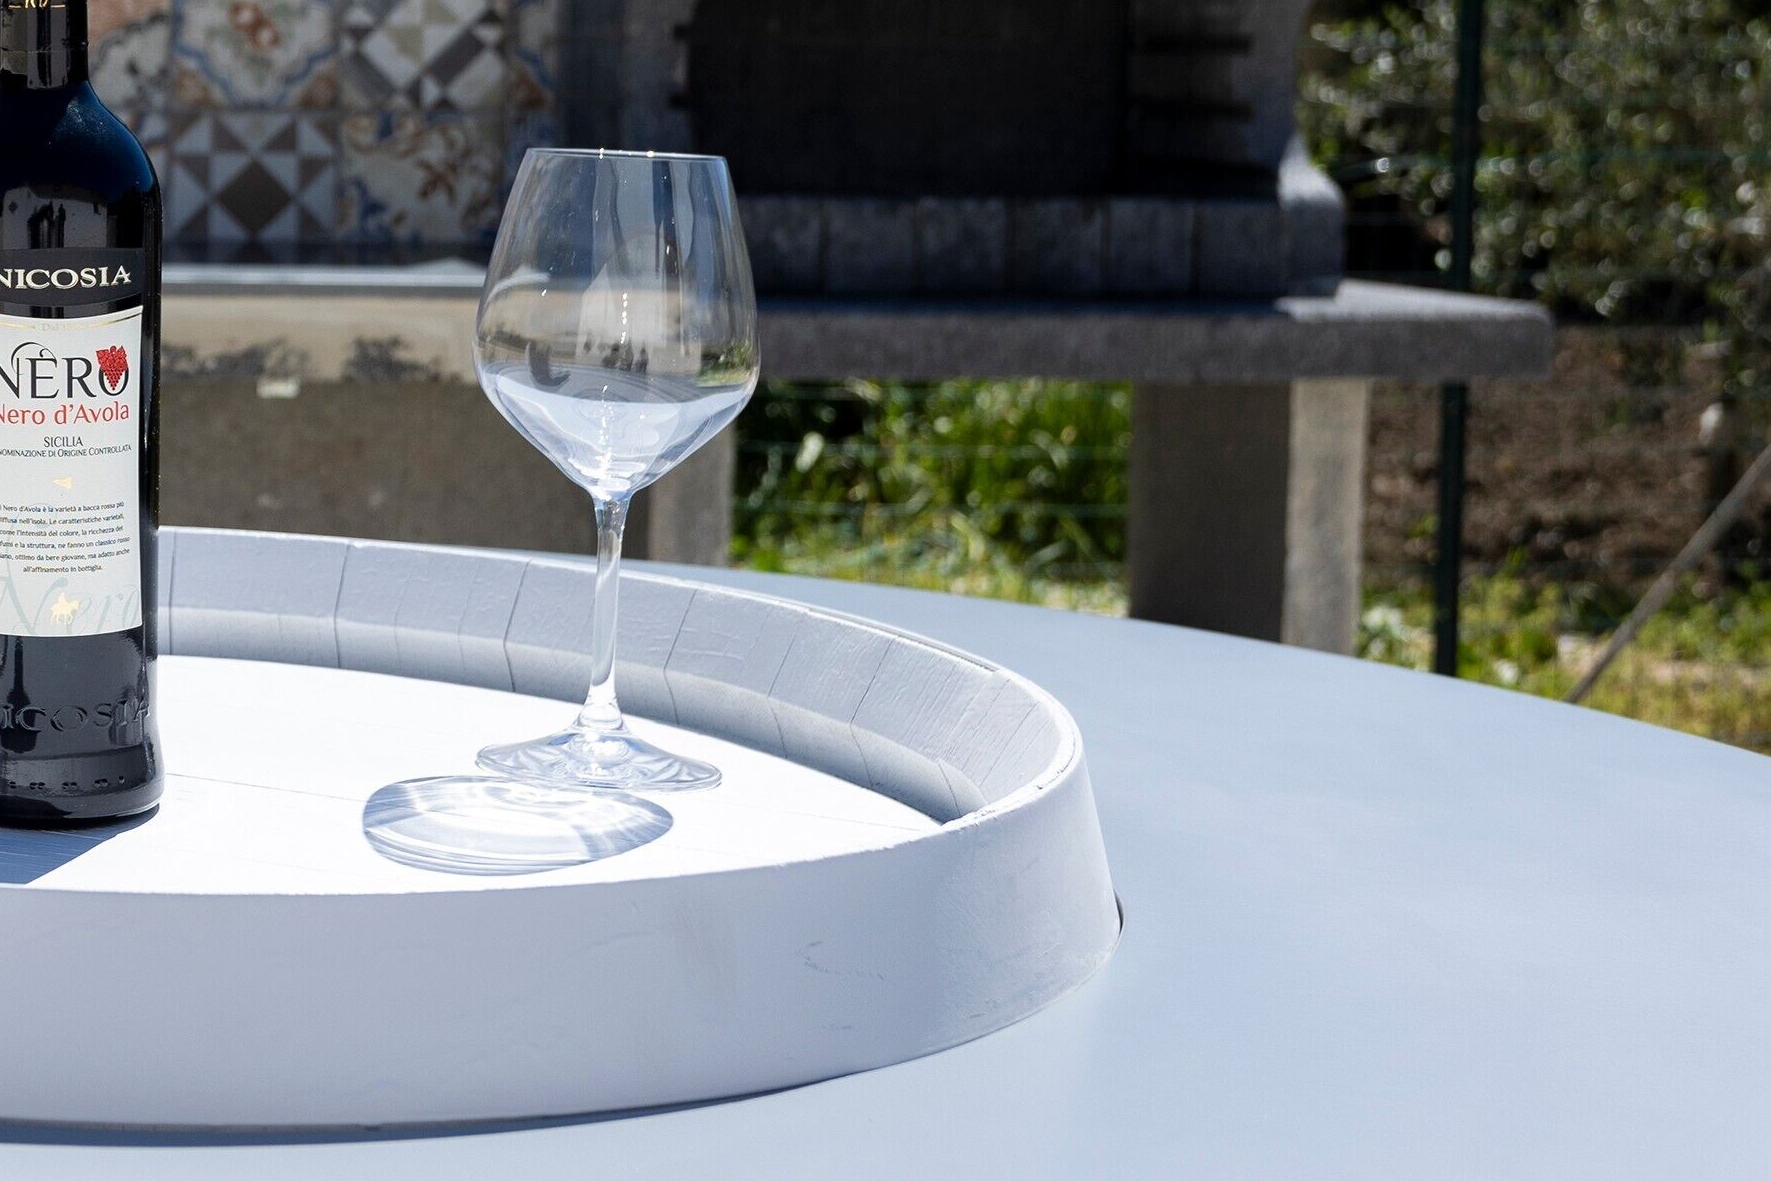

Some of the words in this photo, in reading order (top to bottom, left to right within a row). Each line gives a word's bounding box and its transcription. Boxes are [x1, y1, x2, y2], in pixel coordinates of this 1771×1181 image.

[54, 401, 129, 425] d'Avola
[43, 436, 84, 448] SICILIA
[57, 448, 87, 458] ORIGINE
